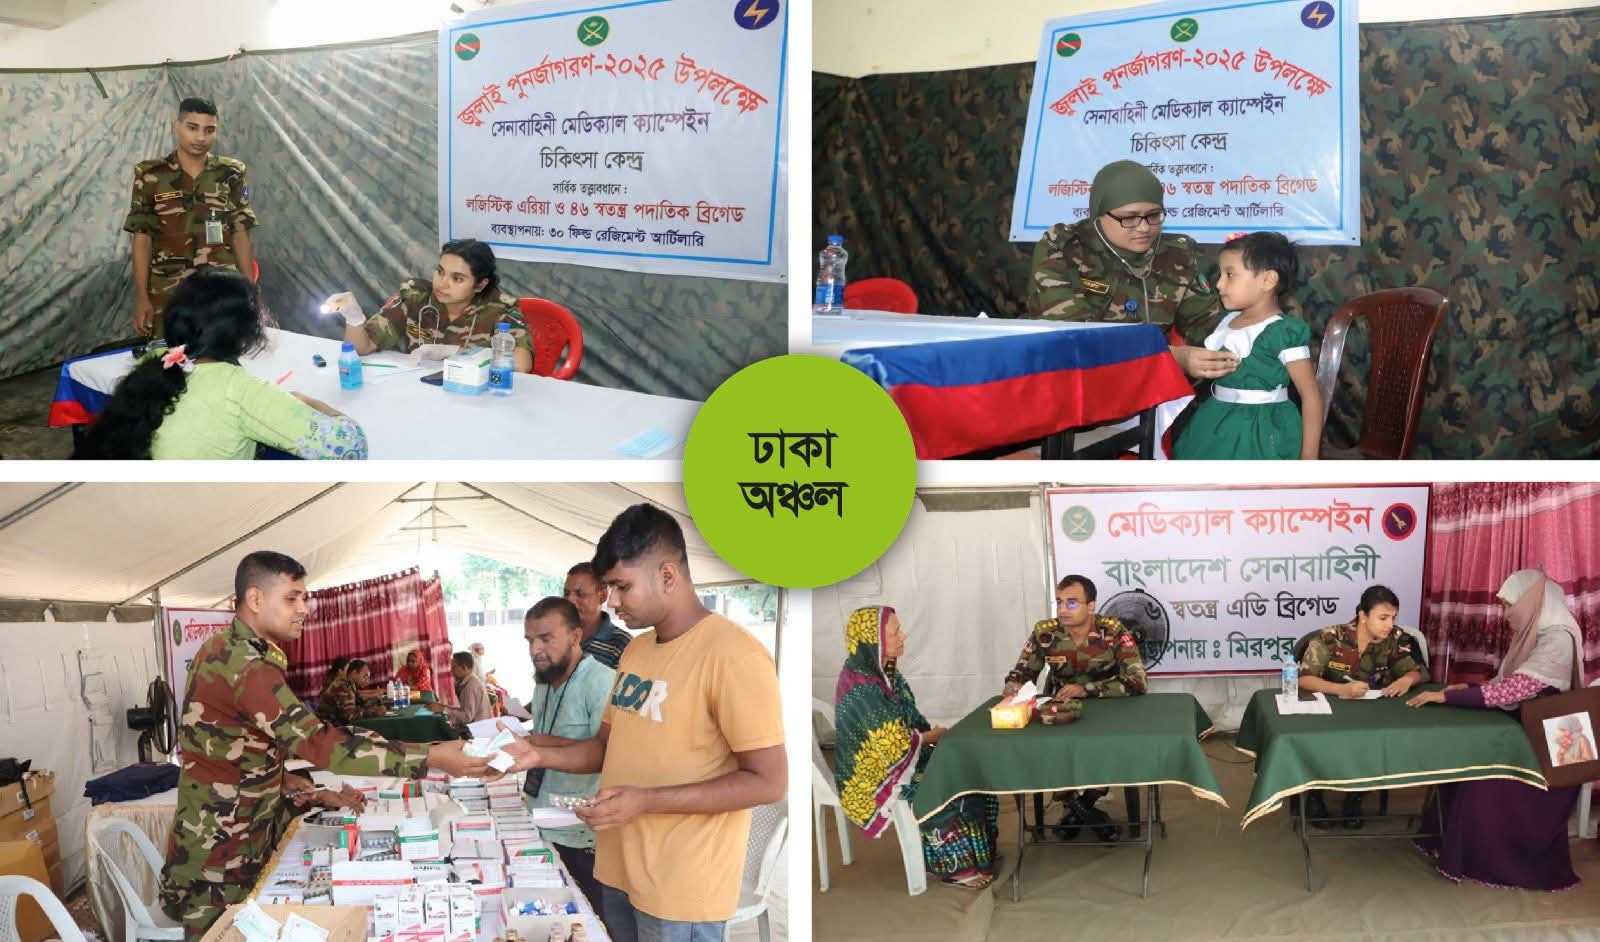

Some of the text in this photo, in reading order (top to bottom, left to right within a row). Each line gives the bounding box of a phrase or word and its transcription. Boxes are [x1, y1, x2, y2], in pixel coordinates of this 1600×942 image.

[457, 52, 768, 126] জুলাই পুনর্জাগরণ-২০২৫ উপলক্ষে
[1050, 47, 1332, 116] জুলাই পুনর্জাগরণ-২০২৫ উপলক্ষে
[491, 106, 711, 138] সেনাবাহিনী মেডিক্যাল ক্যাম্পেইন
[1083, 91, 1286, 127] সেনাবাহিনী মেডিক্যাল ক্যাম্পেইন
[1130, 131, 1229, 153] চিকিৎসা কেন্দ্র
[539, 147, 645, 173] চিকিৎসা কেন্দ্র
[552, 181, 577, 194] সার্বিক
[1181, 180, 1213, 197] স্বতন্ত্র
[1219, 175, 1271, 196] পদাতিক
[1276, 174, 1319, 196] ব্রিগেড
[465, 195, 746, 224] লজিস্টিক এরিয়া ও ৪৬ স্বতন্ত্র পদাতিক ব্রিগেড
[1181, 204, 1231, 219] রেজিমেন্ট
[1236, 203, 1286, 218] আর্টিলারি
[549, 228, 564, 239] ৩০
[595, 227, 647, 244] রেজিমেন্ট
[651, 228, 705, 248] আর্টিলারি
[1107, 498, 1374, 538] মেডিক্যাল ক্যাম্পেইন
[1101, 543, 1381, 587] বাংলাদেশ সেনাবাহিনী
[1170, 599, 1219, 620] স্বতন্ত্র
[1226, 591, 1270, 619] এডি
[1274, 590, 1340, 621] ব্রিগেড
[1226, 631, 1297, 662] মিরপুর
